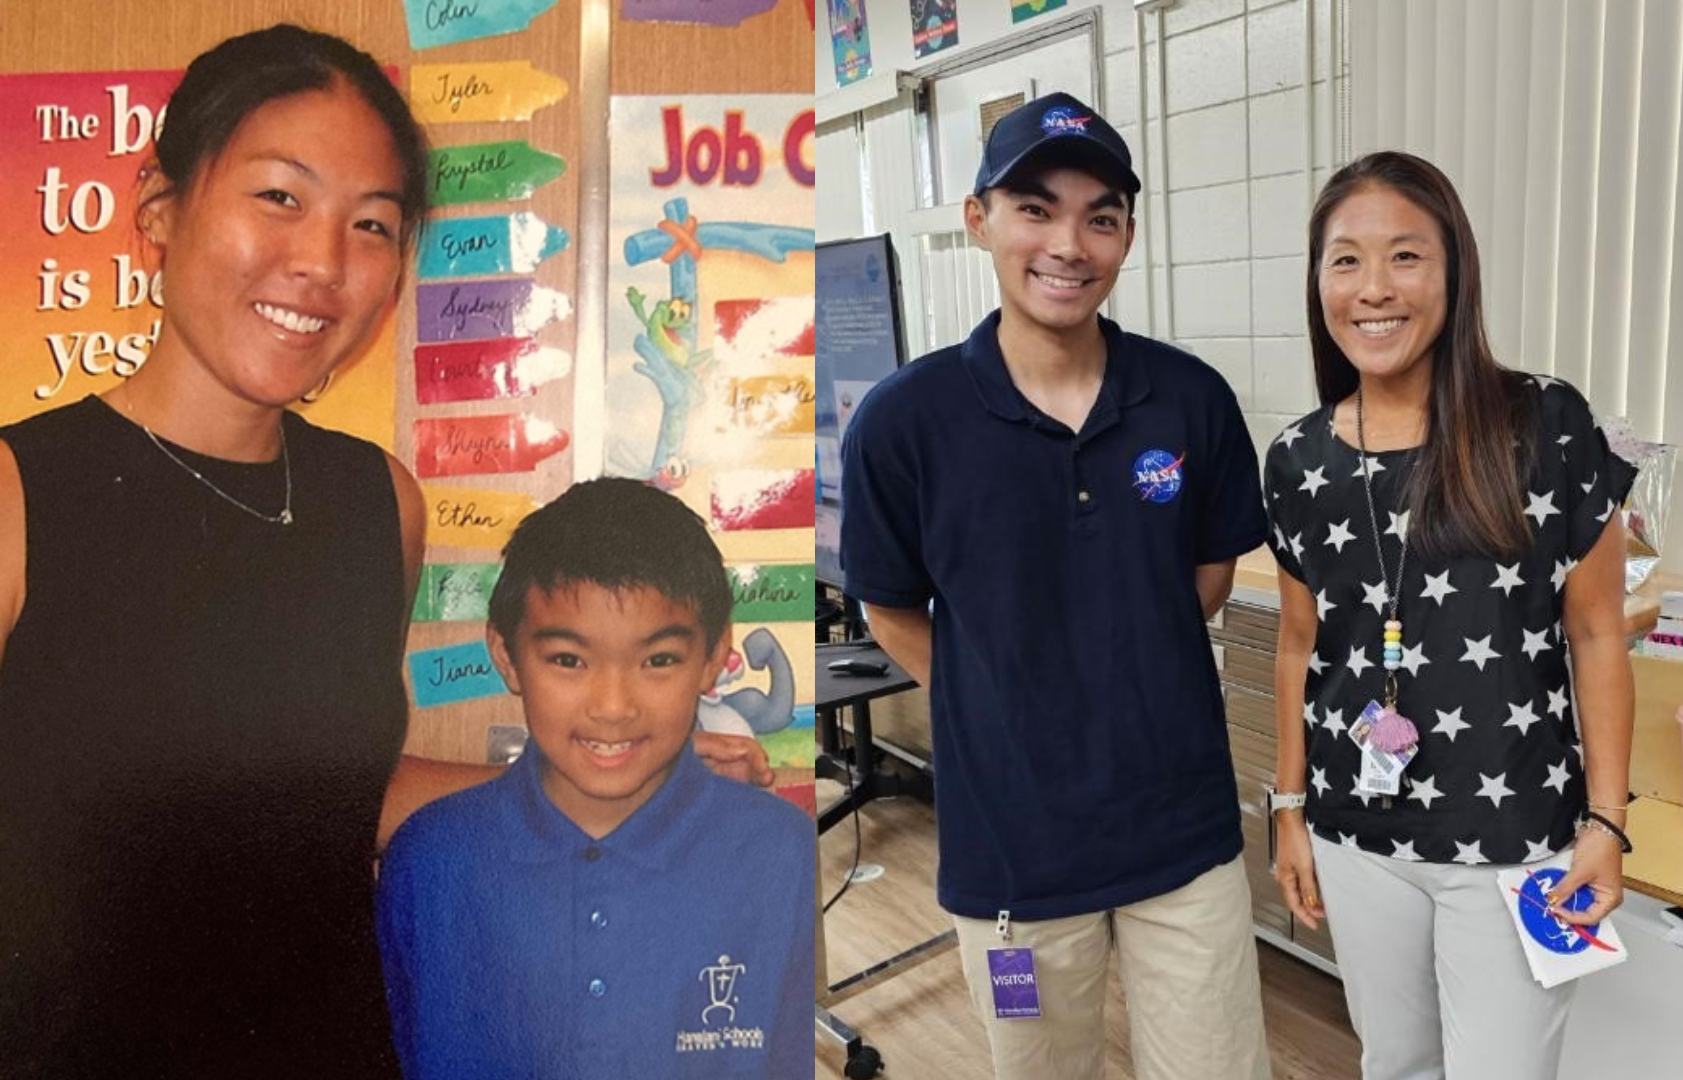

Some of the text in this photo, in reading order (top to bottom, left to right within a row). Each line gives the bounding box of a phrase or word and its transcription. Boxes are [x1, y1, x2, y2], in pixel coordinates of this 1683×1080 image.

[432, 73, 494, 114] Tyler
[35, 104, 99, 143] The
[1044, 117, 1085, 132] NASA
[649, 104, 762, 188] Job
[37, 167, 116, 235] to
[441, 233, 498, 259] Evan
[36, 258, 91, 311] is
[1137, 470, 1180, 483] NASA
[428, 656, 492, 687] Tiana
[1536, 876, 1580, 949] NA
[992, 973, 1035, 986] VISITOR
